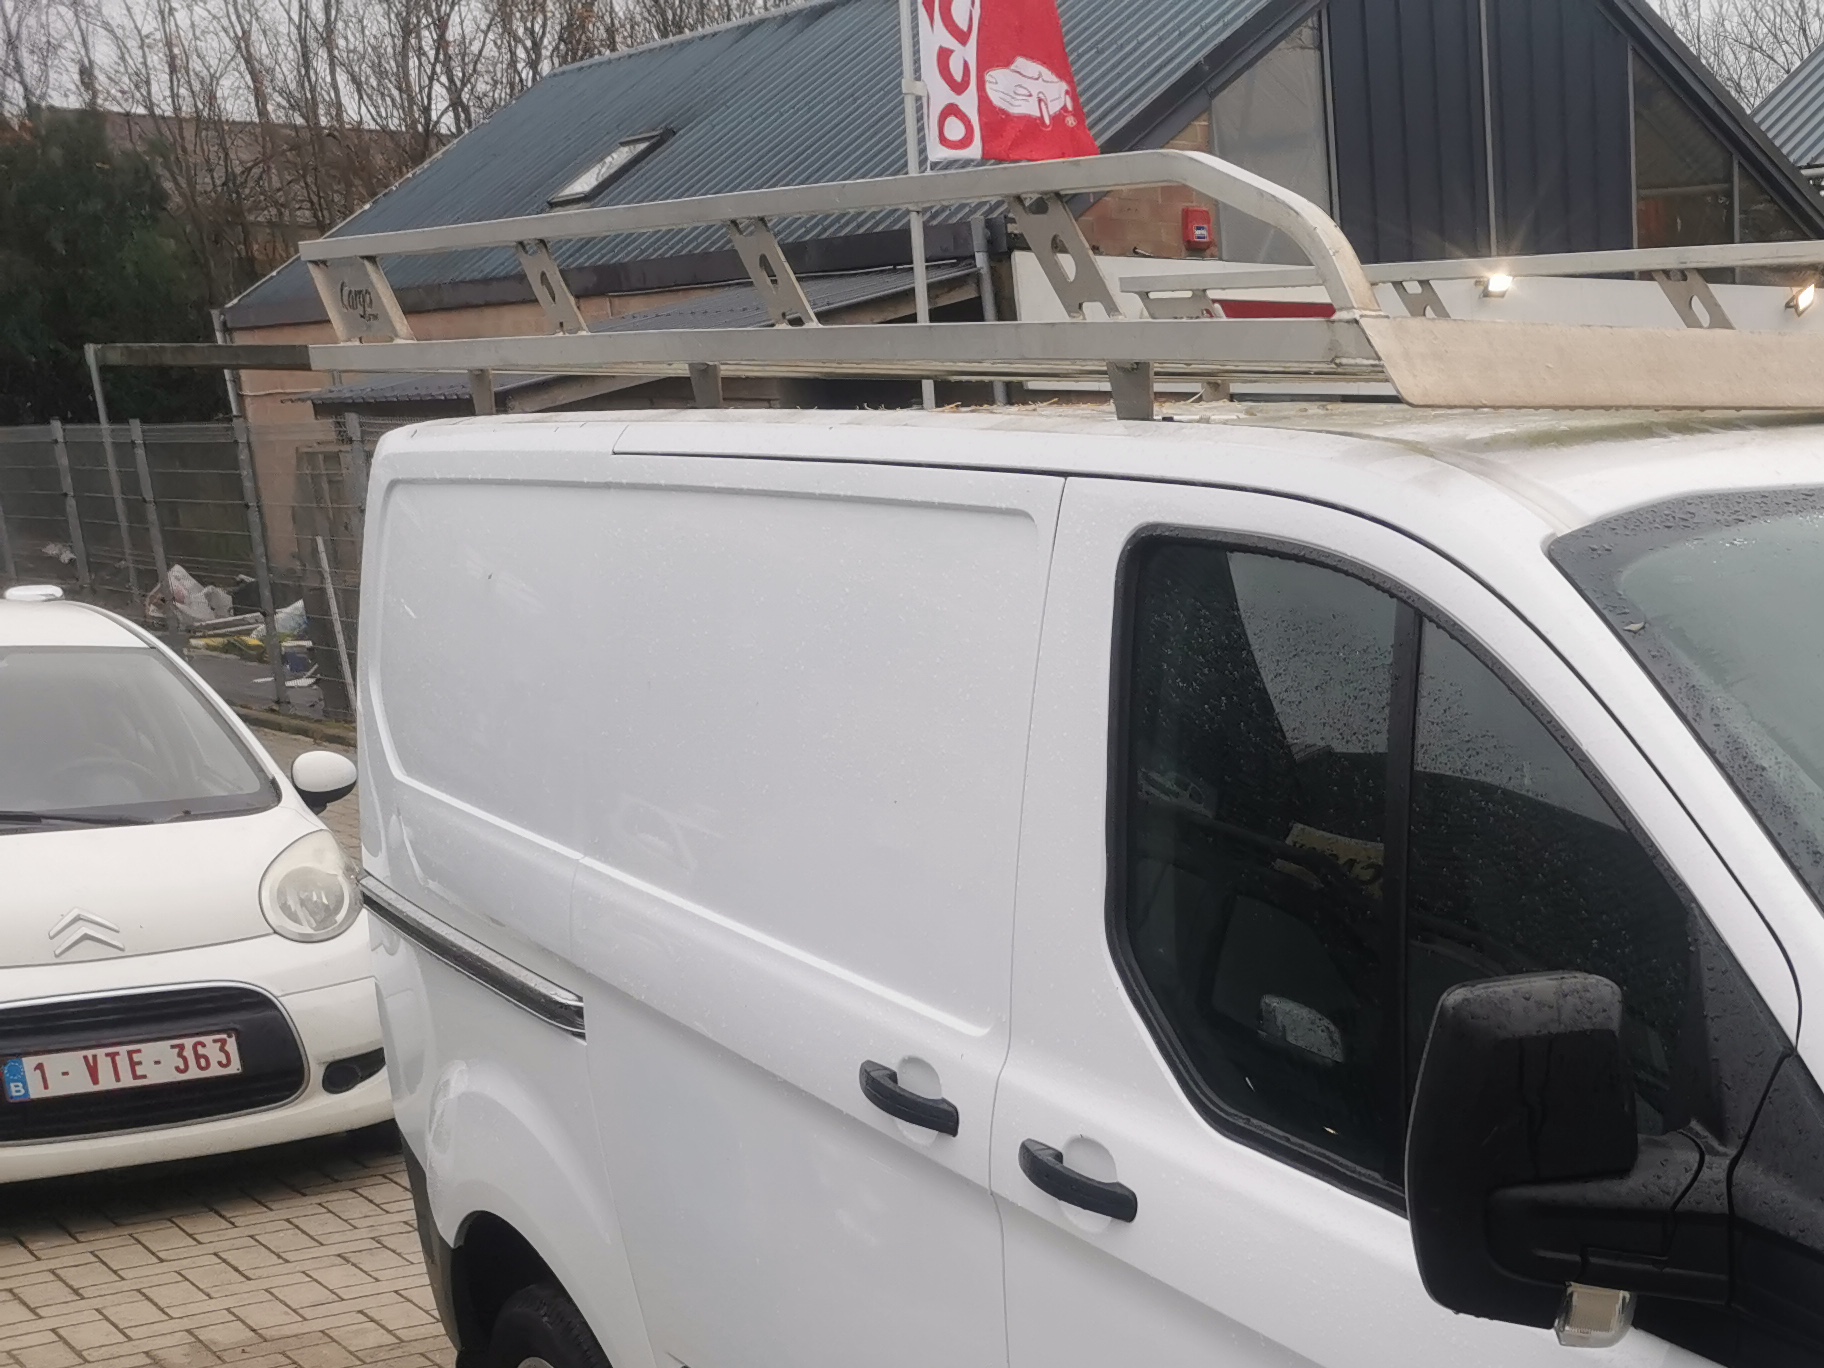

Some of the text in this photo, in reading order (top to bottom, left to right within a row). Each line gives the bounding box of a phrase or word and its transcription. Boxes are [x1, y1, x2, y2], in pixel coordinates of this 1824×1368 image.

[340, 280, 373, 319] Cargo
[33, 1037, 232, 1091] 1-VTE-363
[10, 1082, 26, 1097] B
